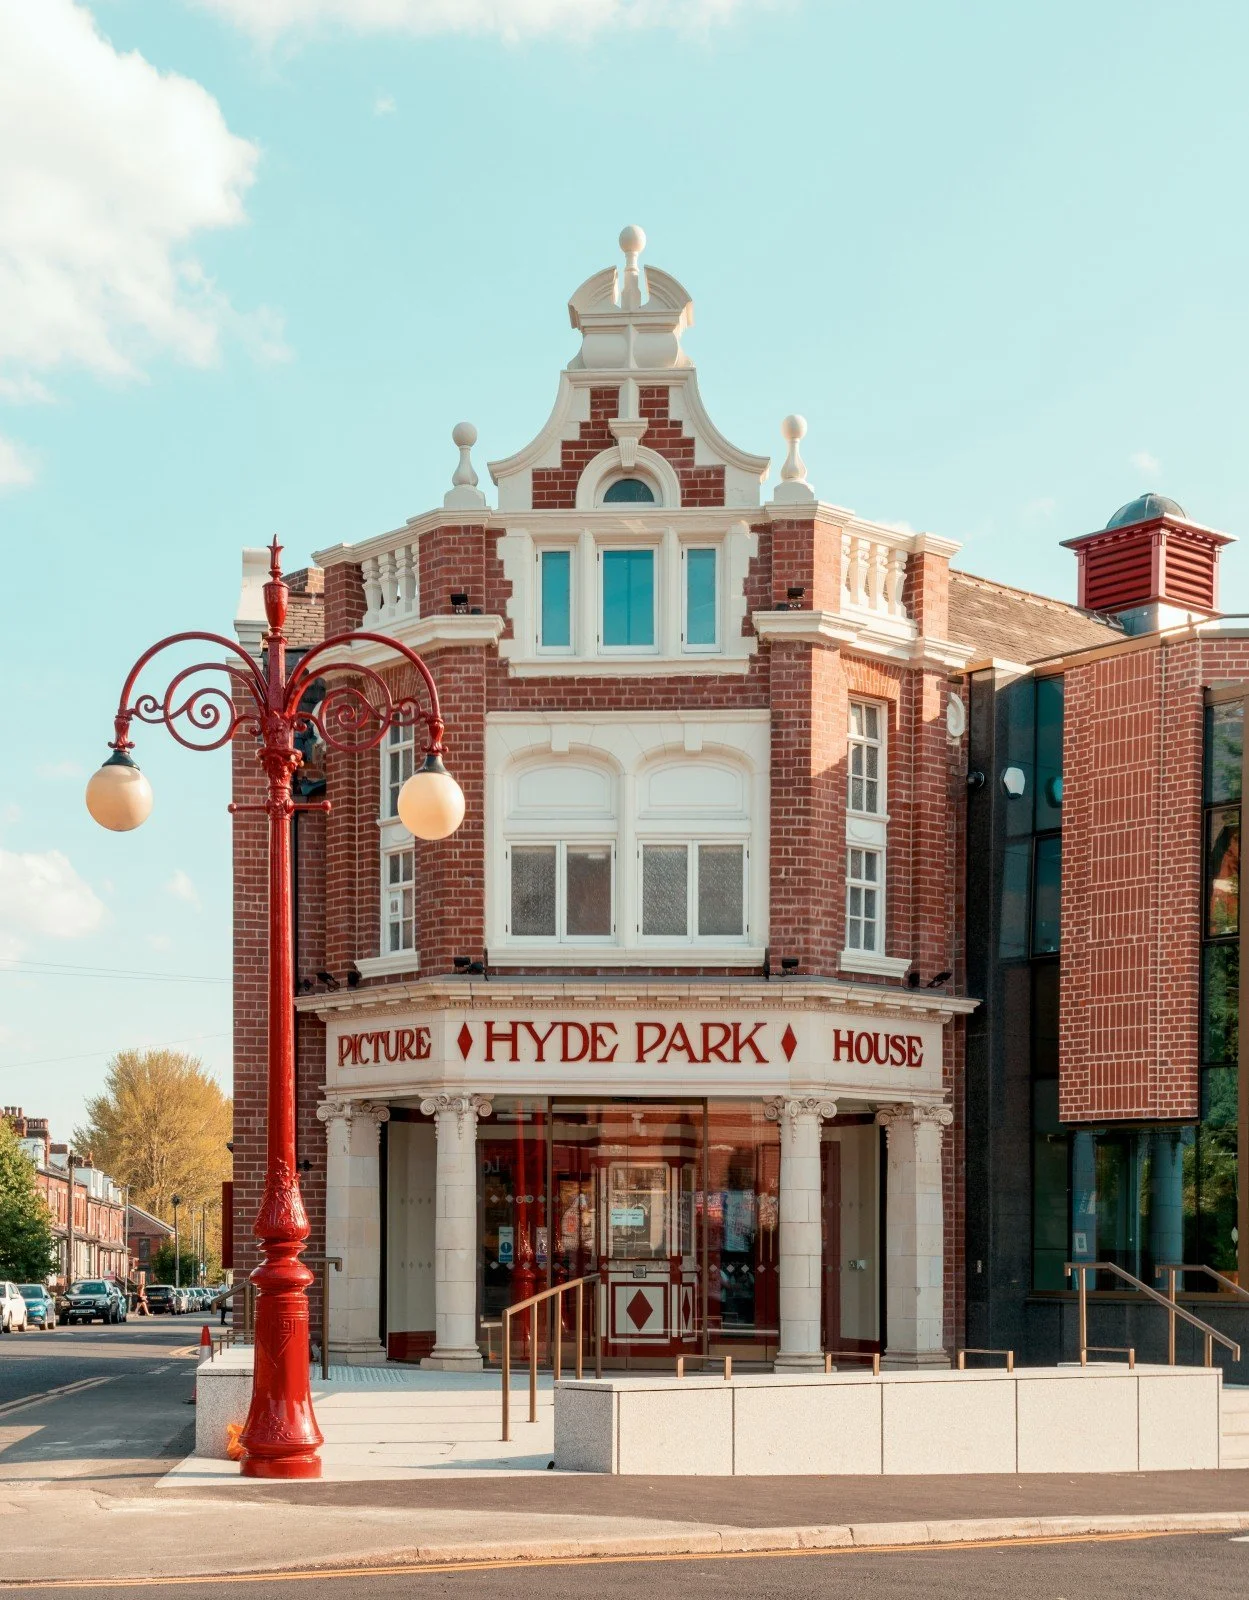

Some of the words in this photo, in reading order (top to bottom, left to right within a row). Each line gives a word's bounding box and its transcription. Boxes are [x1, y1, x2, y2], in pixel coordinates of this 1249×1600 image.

[337, 1026, 432, 1067] PICTURE
[484, 1021, 618, 1063] HYDE
[635, 1022, 769, 1064] PARK
[832, 1028, 923, 1068] HOUSE
